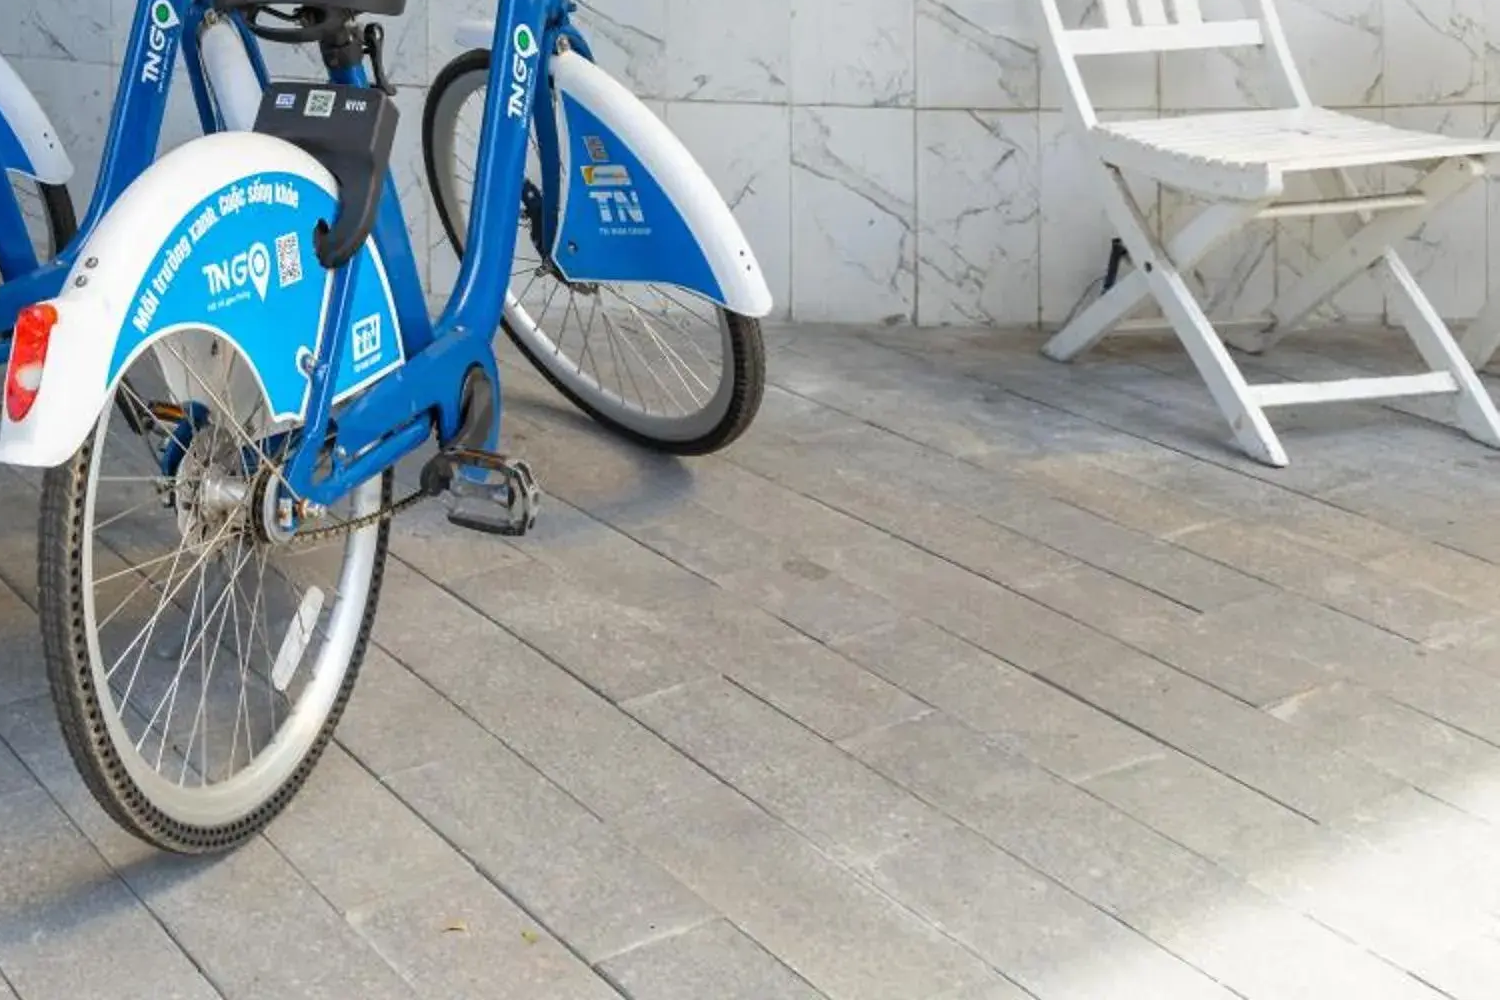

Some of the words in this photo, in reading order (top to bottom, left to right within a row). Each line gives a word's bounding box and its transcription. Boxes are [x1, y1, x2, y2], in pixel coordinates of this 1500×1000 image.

[508, 24, 539, 118] TNGO
[588, 191, 645, 223] TN
[132, 288, 160, 334] Môi
[152, 235, 192, 296] trường
[218, 185, 246, 216] Cuộc
[247, 176, 273, 205] sống
[202, 241, 271, 304] TNGO
